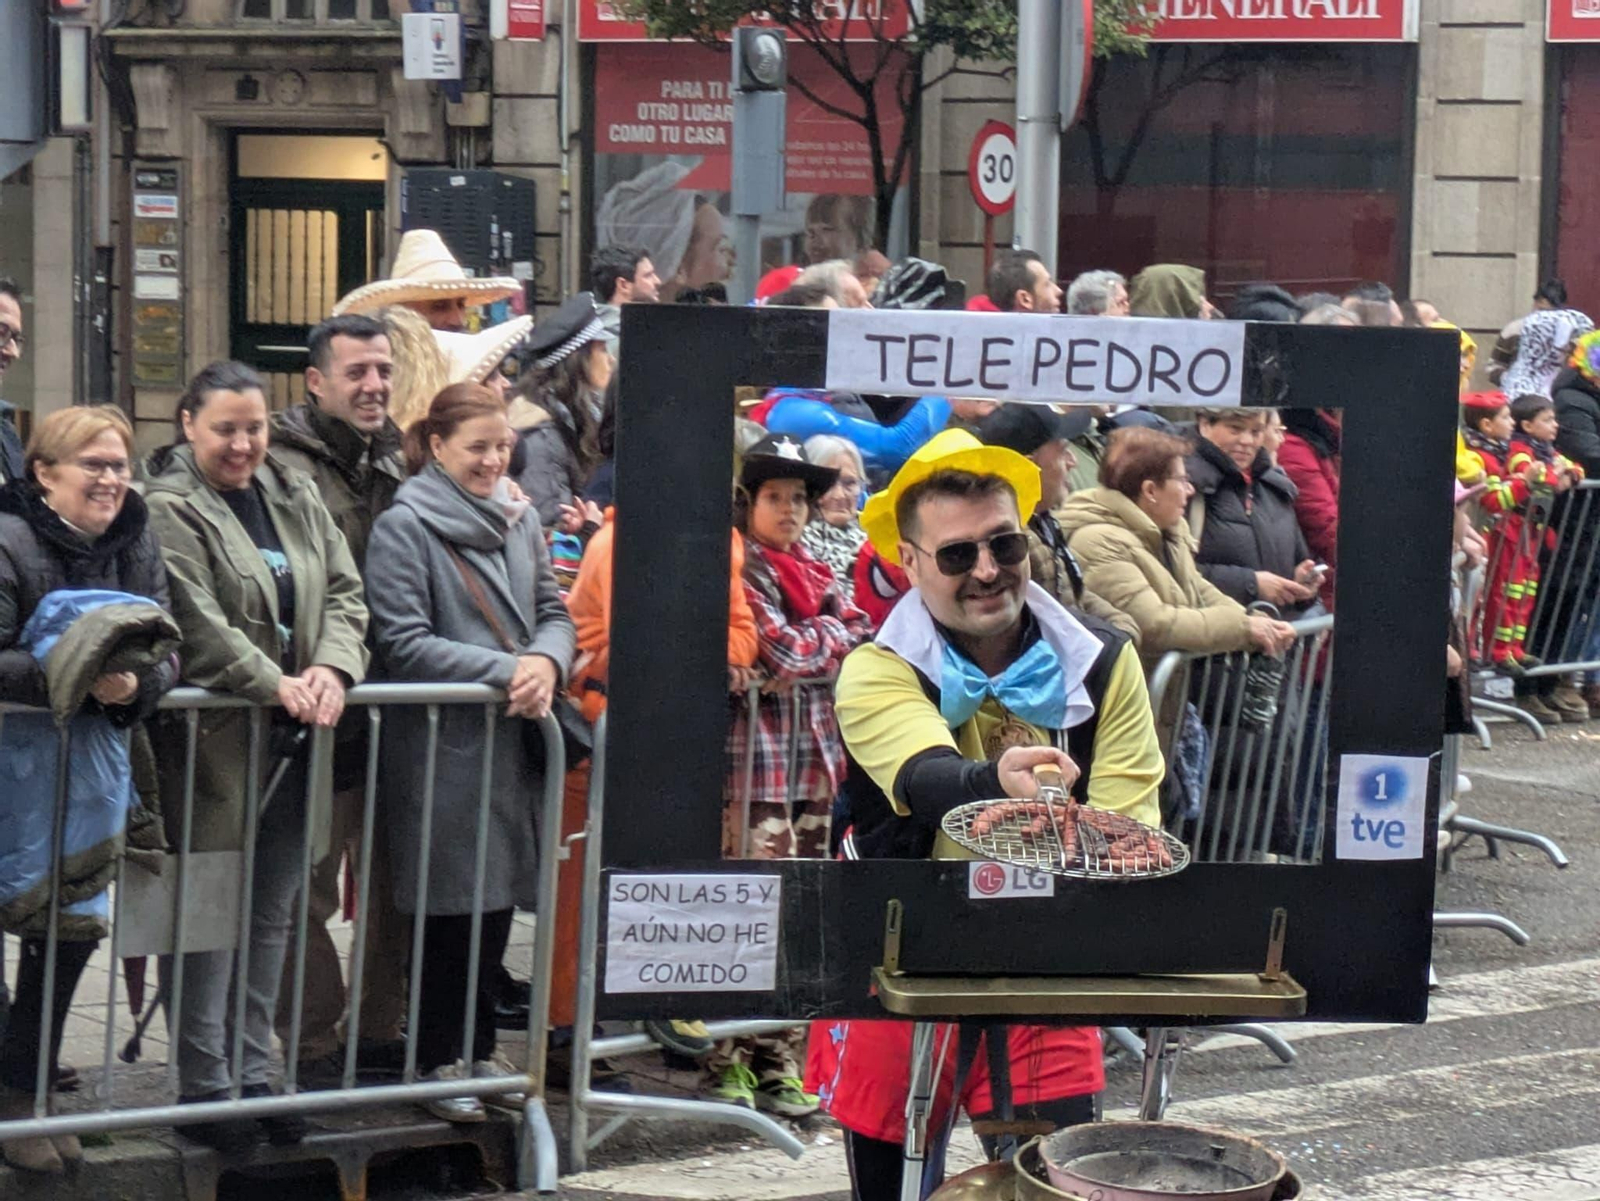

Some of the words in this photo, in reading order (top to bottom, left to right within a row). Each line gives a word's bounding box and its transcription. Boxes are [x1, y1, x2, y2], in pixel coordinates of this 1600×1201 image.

[661, 80, 703, 99] PARA
[708, 81, 723, 99] TI
[638, 102, 679, 120] OTRO
[683, 103, 734, 122] LUGAR
[609, 124, 656, 143] COMO
[660, 125, 680, 143] TU
[684, 126, 726, 145] CASA
[983, 154, 1014, 183] 30
[1031, 337, 1231, 397] PEDRO
[1374, 773, 1388, 800] 1
[1350, 812, 1406, 849] tve
[1012, 868, 1047, 890] LG
[612, 882, 670, 903] SON
[678, 883, 727, 904] LAS
[736, 883, 750, 904] 5
[758, 883, 774, 904] Y
[622, 915, 678, 944] AÚN
[686, 923, 726, 944] NO
[734, 922, 769, 944] HE
[638, 963, 748, 984] COMIDO
